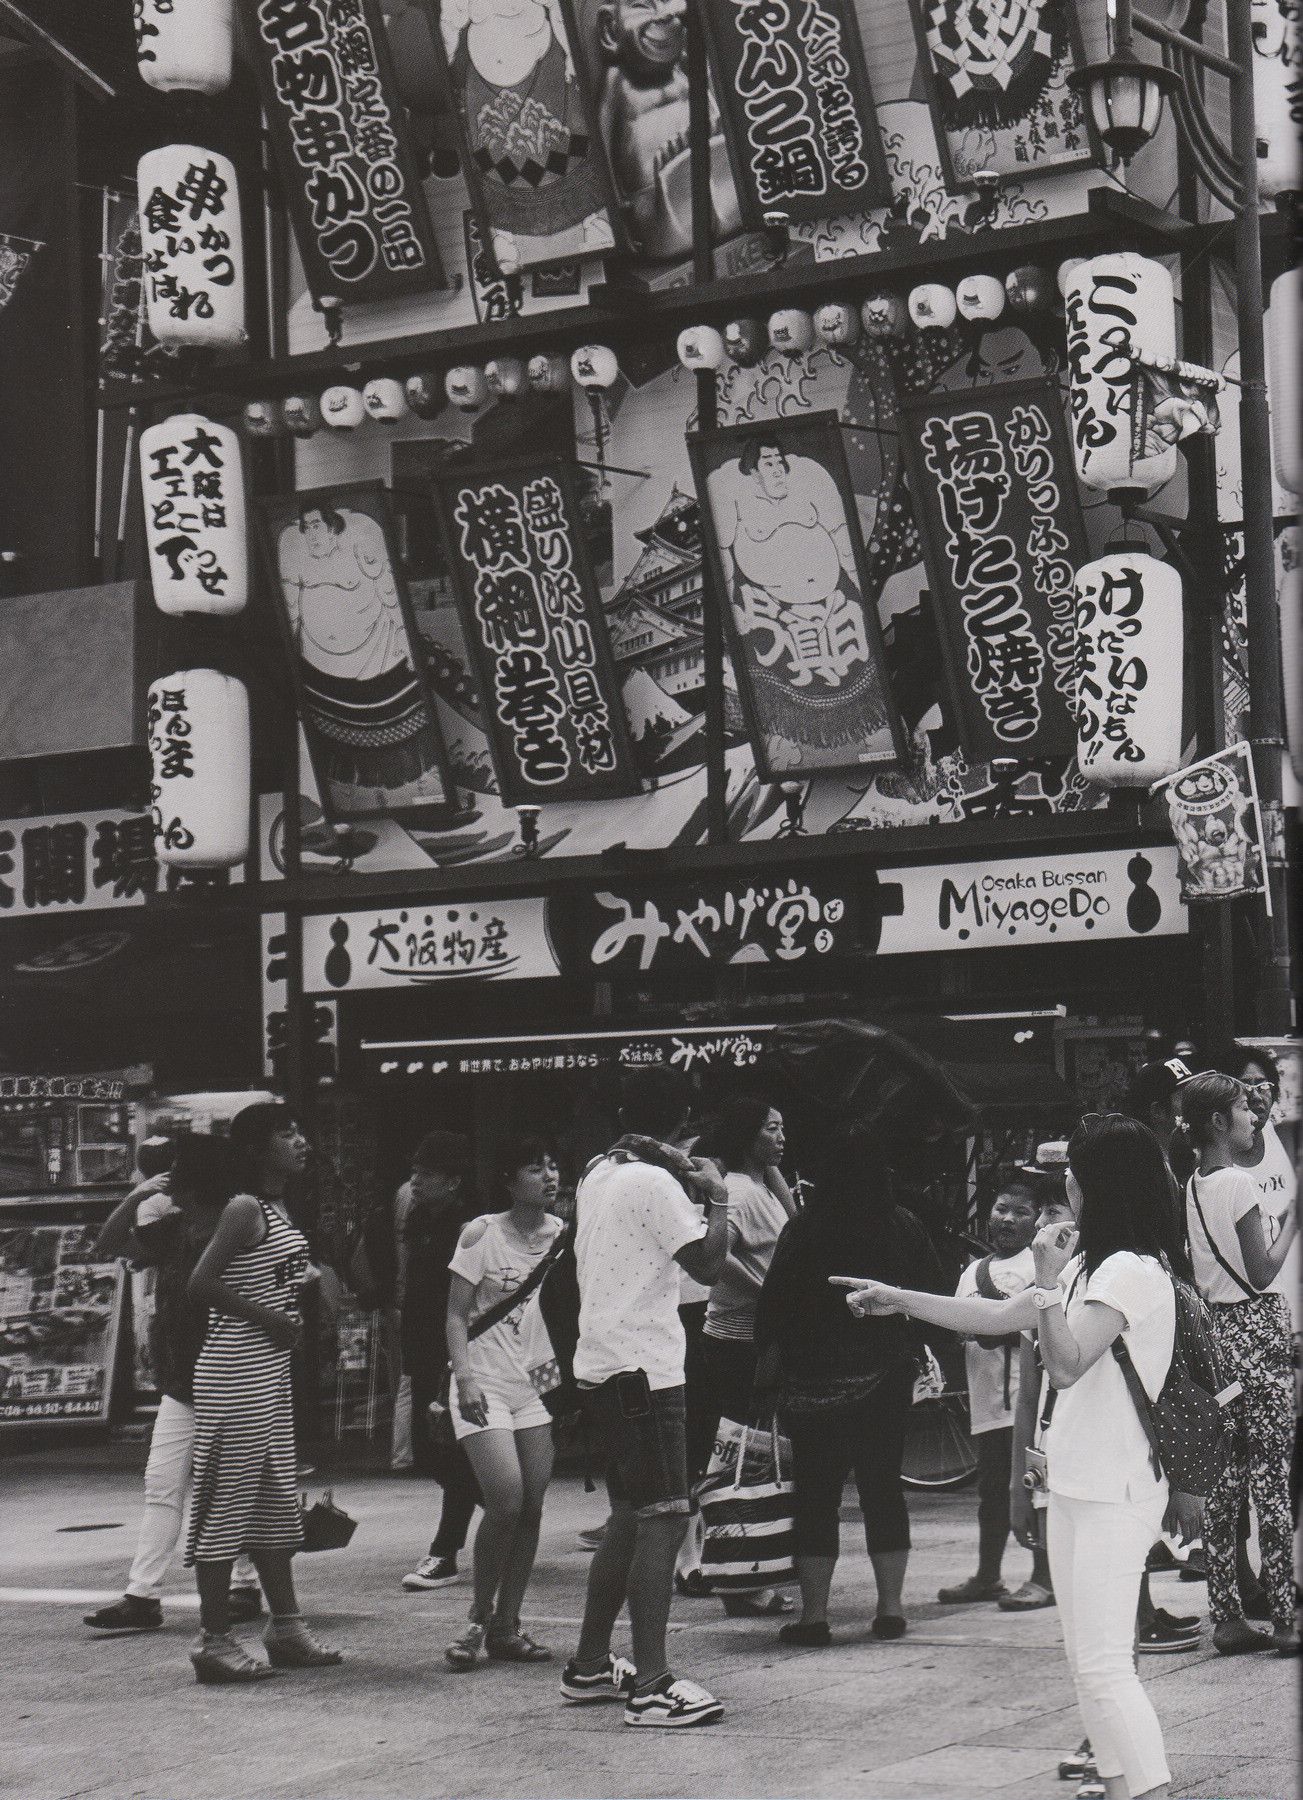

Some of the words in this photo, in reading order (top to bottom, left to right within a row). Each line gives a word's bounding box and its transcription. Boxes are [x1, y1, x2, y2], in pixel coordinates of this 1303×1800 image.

[176, 159, 235, 286] 串かつ
[921, 411, 1044, 742] 揚げたこ焼き
[939, 878, 1110, 930] MiyageDo
[982, 873, 1036, 892] Osaka
[1042, 870, 1108, 888] Bussan
[366, 916, 512, 966] 大阪物産
[591, 879, 820, 970] みやげ堂
